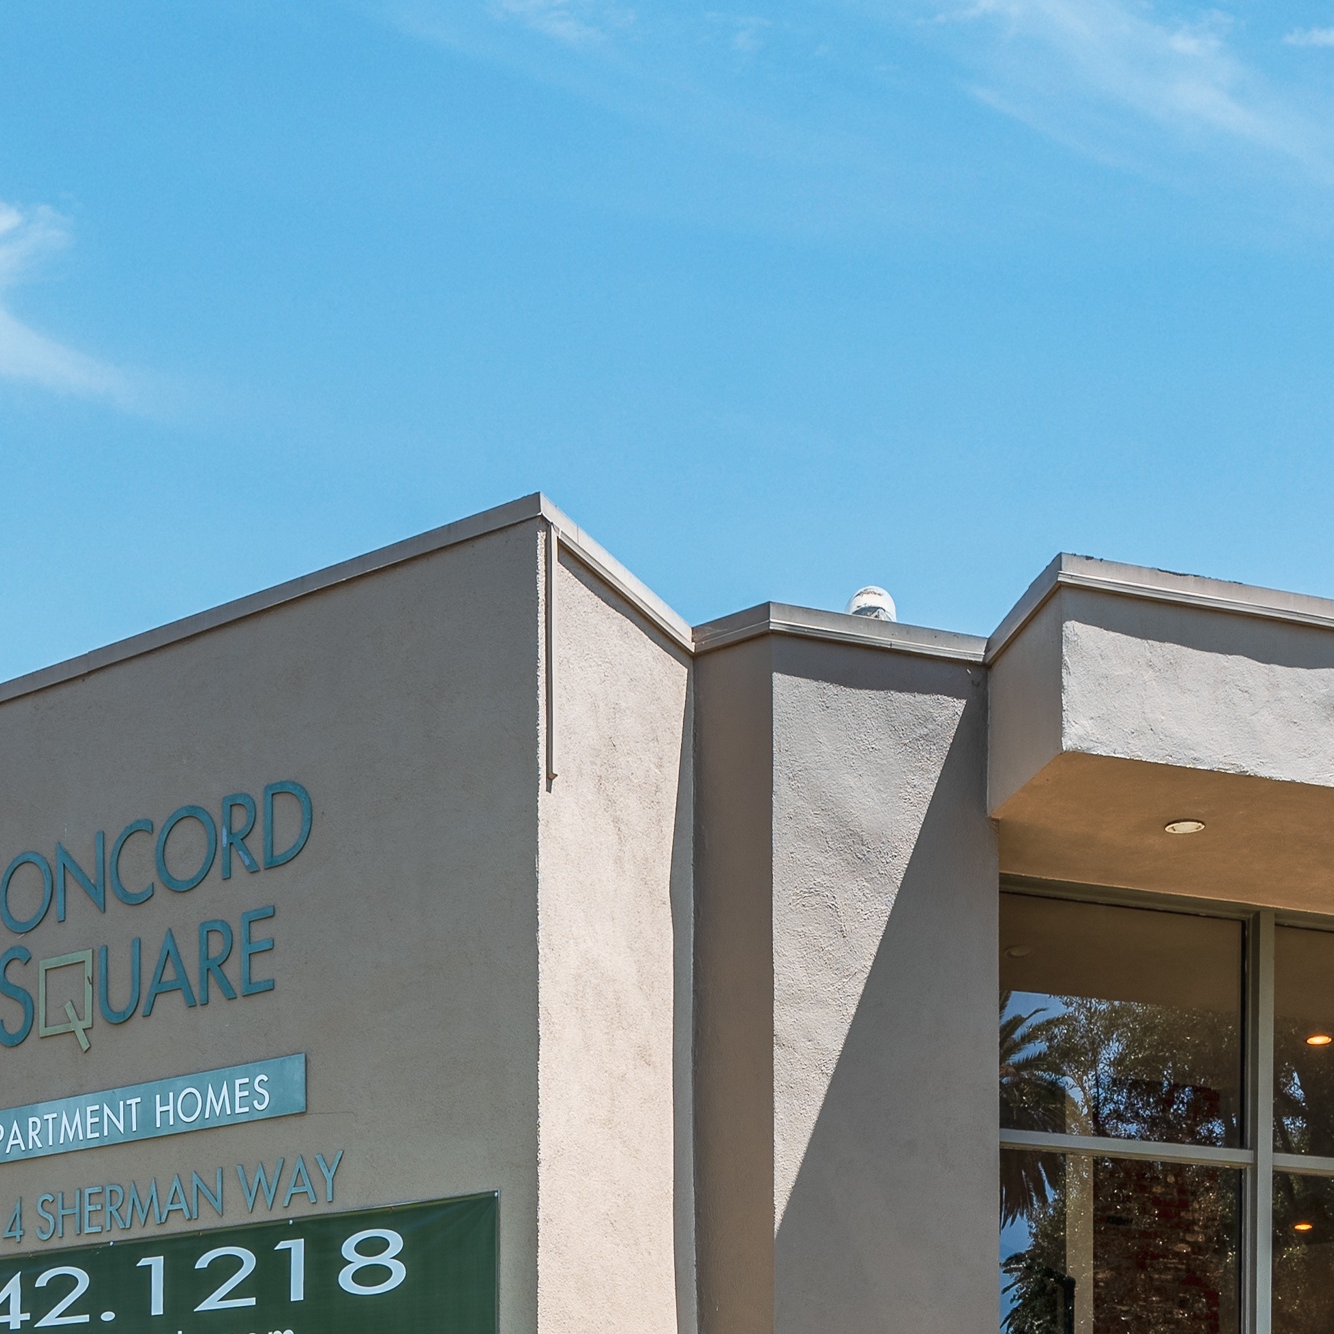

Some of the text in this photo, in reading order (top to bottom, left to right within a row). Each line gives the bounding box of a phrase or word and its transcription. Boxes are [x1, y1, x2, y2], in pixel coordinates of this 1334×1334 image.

[155, 1074, 270, 1128] HOMES
[36, 1167, 223, 1241] SHERMAN
[236, 1150, 344, 1213] WAY
